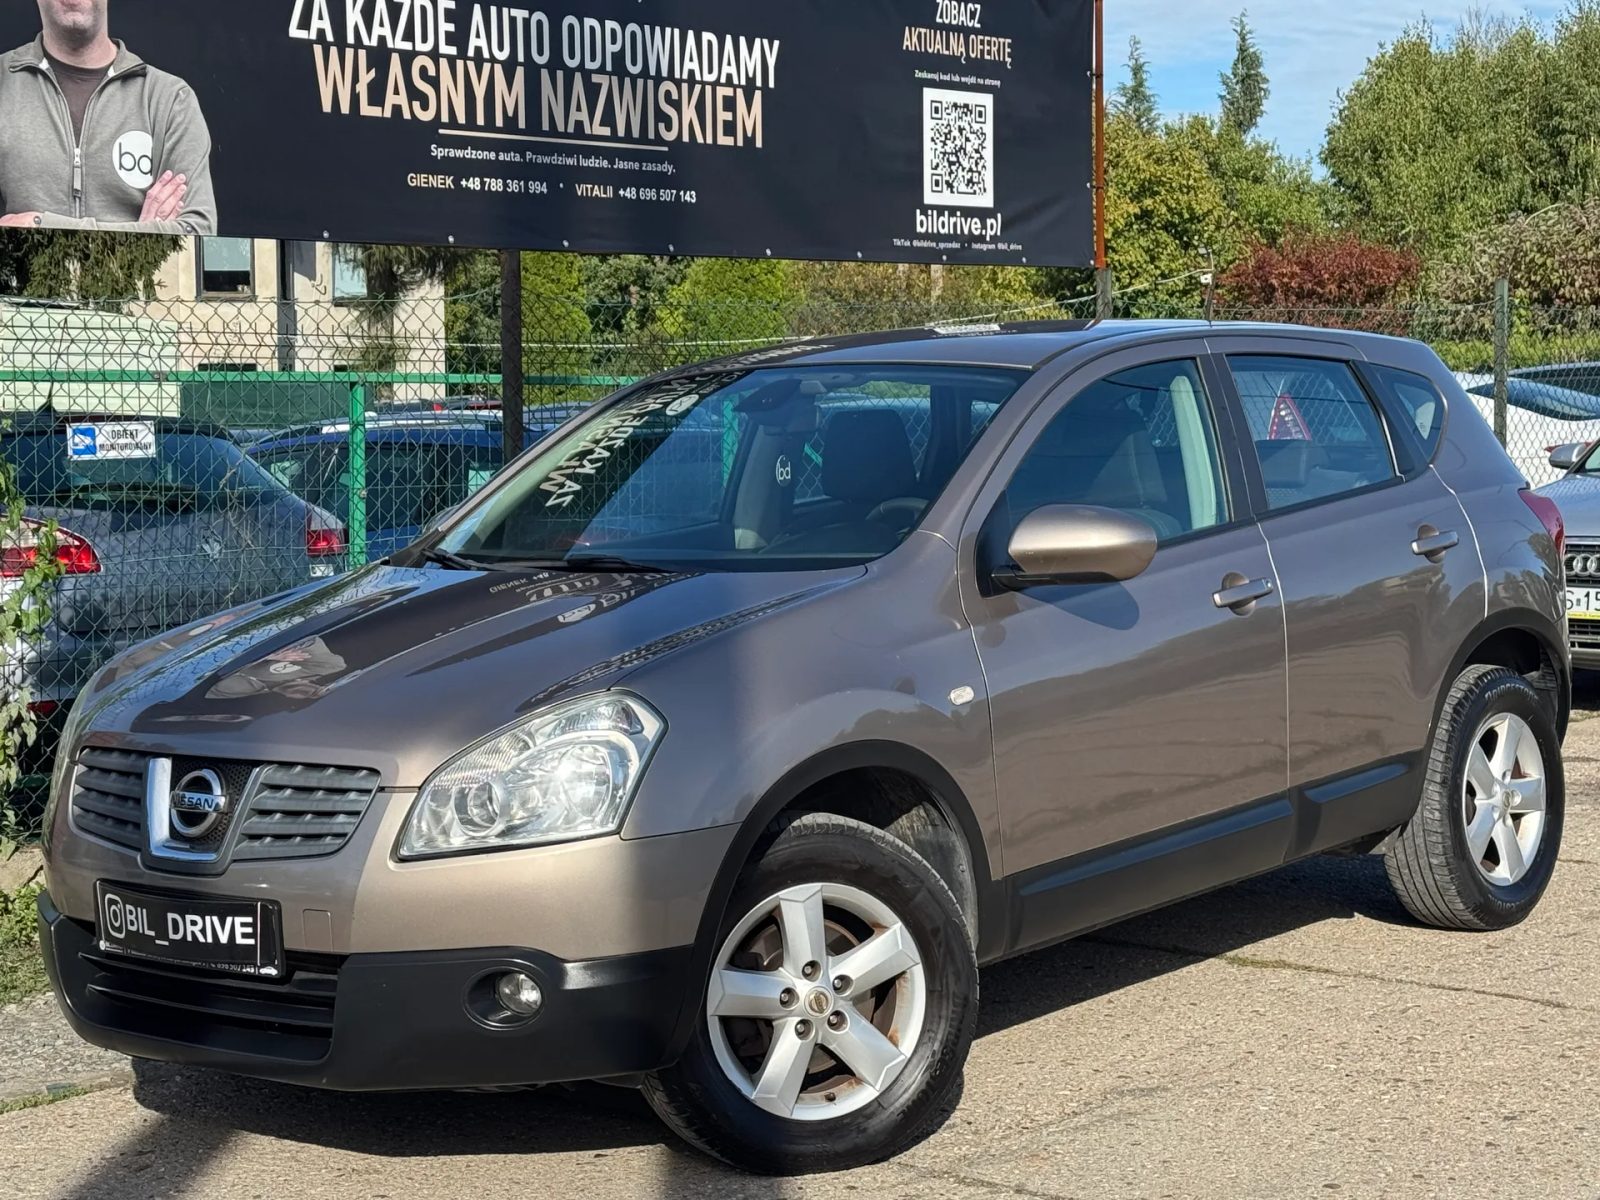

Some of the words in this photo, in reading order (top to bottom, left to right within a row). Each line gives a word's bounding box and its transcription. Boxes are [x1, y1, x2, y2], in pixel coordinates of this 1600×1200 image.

[936, 0, 981, 28] ZOBACZ
[288, 0, 334, 42] ZA
[466, 3, 550, 65] AUTO
[562, 15, 780, 89] ODPOWIADAMY
[902, 26, 966, 64] AKTUALNĄ
[969, 34, 1012, 69] OFERTĘ
[313, 44, 526, 129] WŁASNYM
[540, 68, 763, 148] NAZWISKIEM
[430, 144, 496, 162] Sprawdzone
[498, 151, 524, 162] auta.
[525, 152, 577, 165] Prawdziwi
[579, 154, 611, 168] ludzie.
[613, 158, 640, 171] Jasne
[642, 161, 676, 175] zasady.
[407, 173, 455, 190] GIENEK
[460, 177, 481, 191] +48
[484, 178, 503, 192] 788
[506, 179, 525, 193] 361
[528, 180, 548, 195] 994
[575, 184, 613, 199] VITALII
[618, 187, 637, 200] +48
[639, 188, 657, 201] 696
[659, 189, 677, 202] 507
[679, 190, 697, 204] 143
[916, 209, 1002, 241] bildrive.pl
[892, 238, 911, 247] TikTok
[972, 242, 995, 251] Instagram
[111, 429, 139, 440] OBIEKT
[169, 791, 214, 809] NISSAN
[125, 904, 256, 946] BIL_DRIVE
